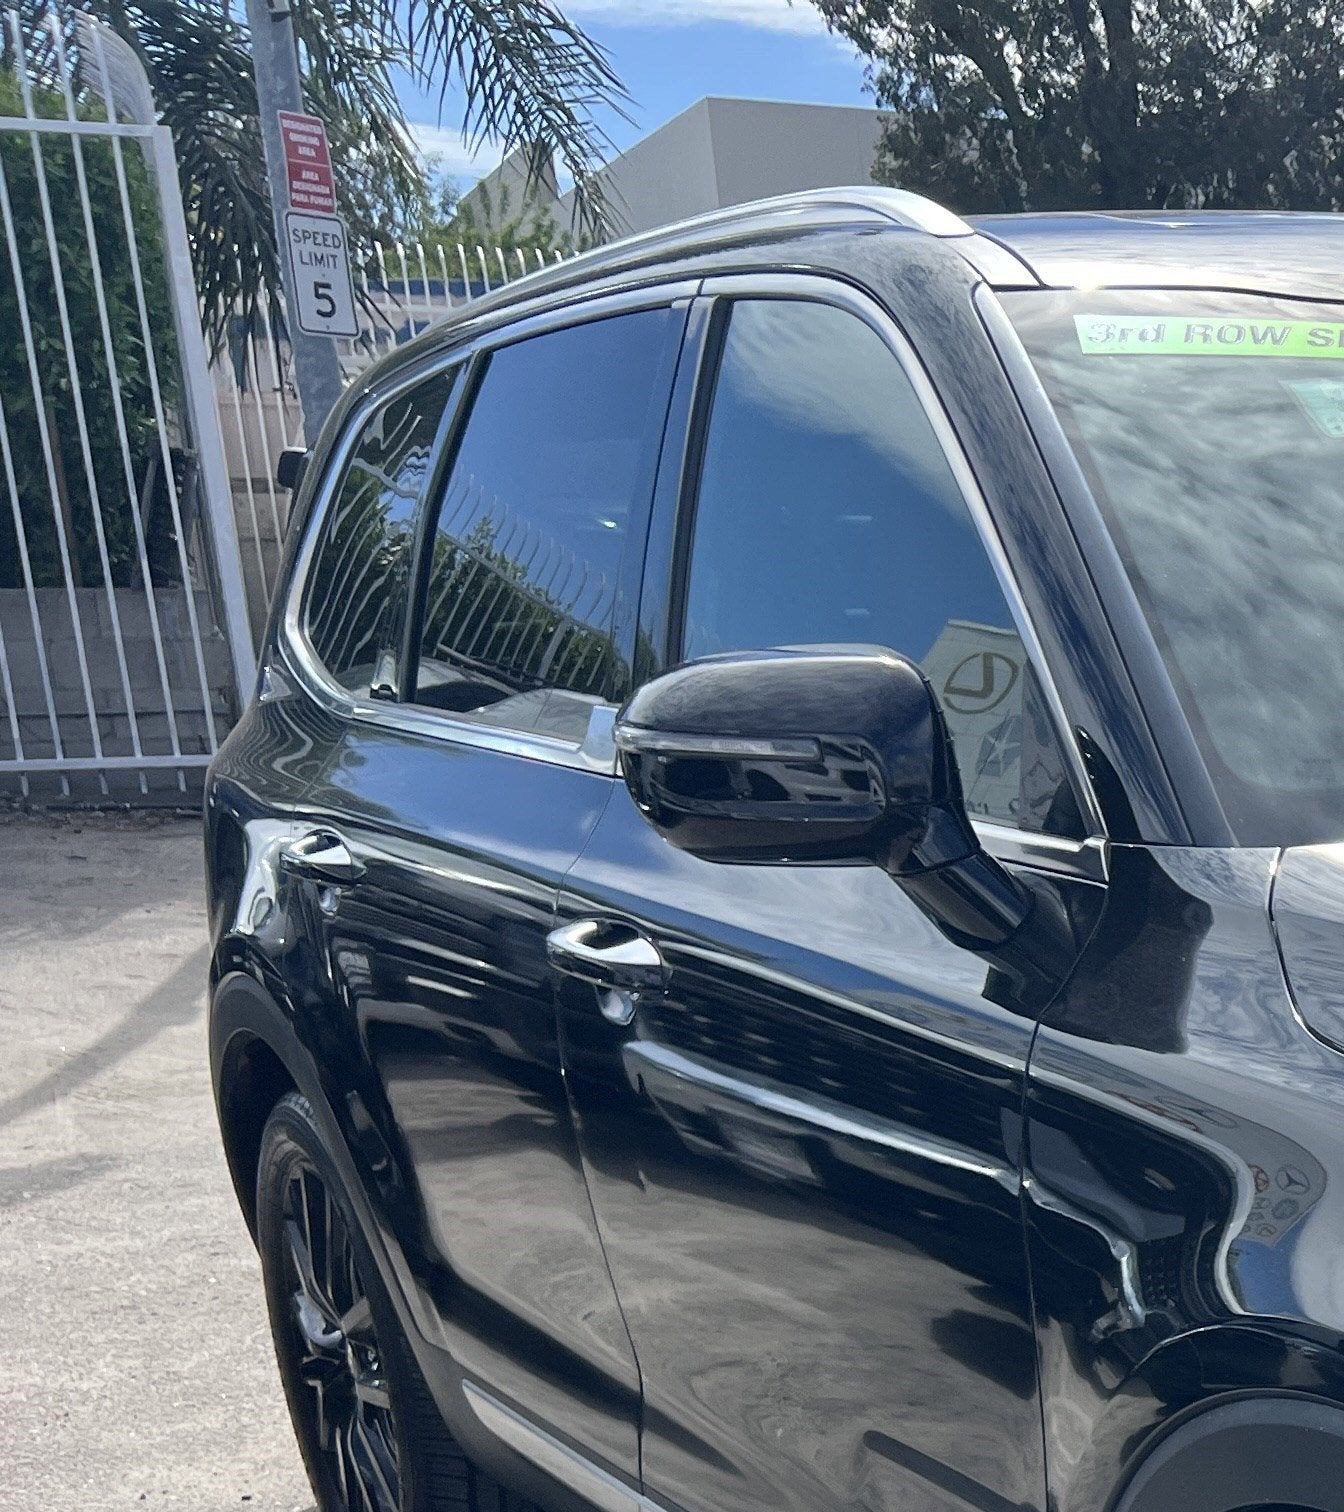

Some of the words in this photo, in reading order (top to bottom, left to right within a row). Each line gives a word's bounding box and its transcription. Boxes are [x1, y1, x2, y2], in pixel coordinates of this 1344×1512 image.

[292, 228, 342, 249] SPEED
[300, 249, 338, 270] LIMIT
[313, 281, 337, 319] 5
[1087, 322, 1166, 344] 3rd
[1184, 324, 1291, 347] ROW
